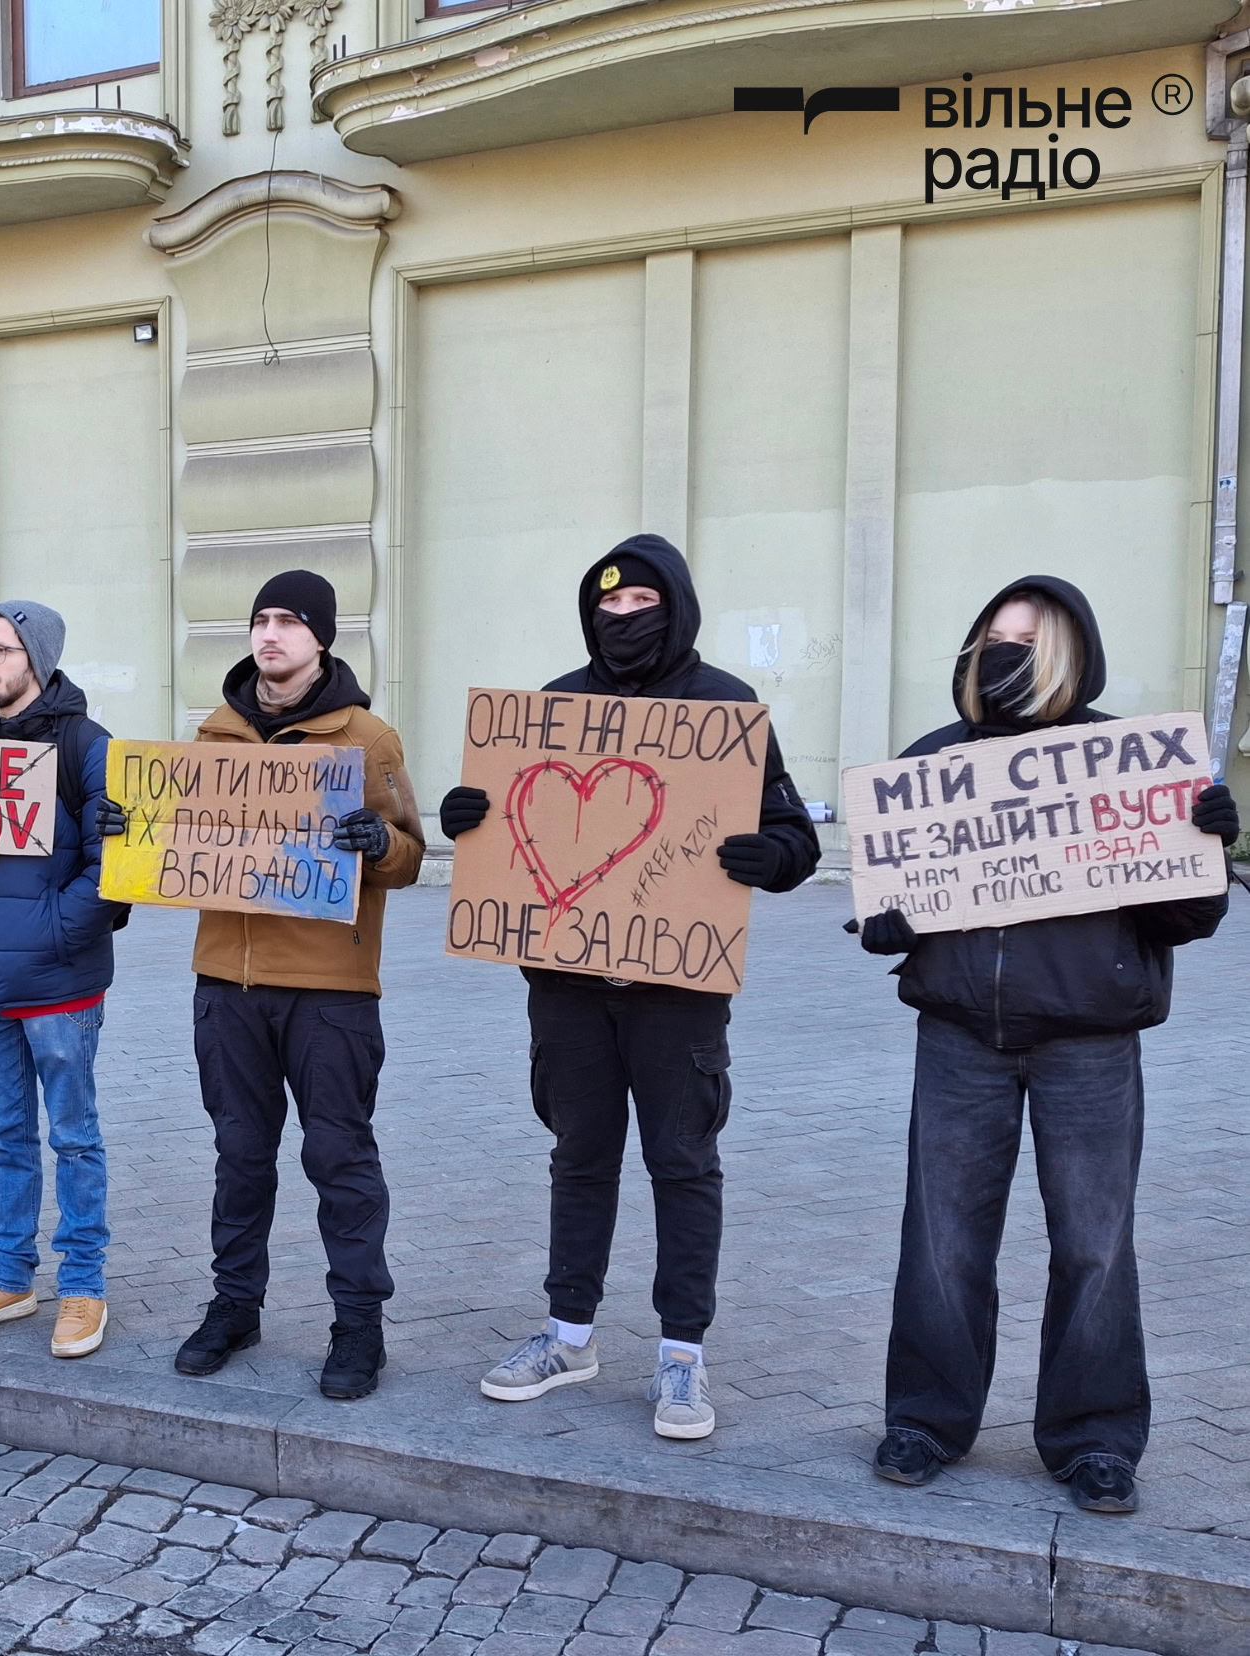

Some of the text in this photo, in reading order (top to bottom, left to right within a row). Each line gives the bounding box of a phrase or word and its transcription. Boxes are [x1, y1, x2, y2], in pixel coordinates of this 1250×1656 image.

[469, 693, 767, 767] ОДНЕ НА ДВОХ
[124, 755, 201, 800] ПОКИ
[215, 758, 250, 798] ТИ
[873, 727, 1196, 814] МІЙ СТРАХ
[123, 803, 338, 850] ЇХ ПОВІЛЬНО
[629, 803, 719, 909] #FREE AZOV
[864, 827, 919, 869] ЦЕ
[926, 793, 1084, 858] ЗАШИТІ
[905, 831, 1160, 888] НАМ ВСІМ ПІЗДА
[158, 849, 349, 905] ВБИВАЮТЬ
[879, 853, 1210, 920] ЯКЩО ГОЛОС СТИХНЕ
[450, 899, 744, 987] ОДНЕ ЗА ДВОХ
